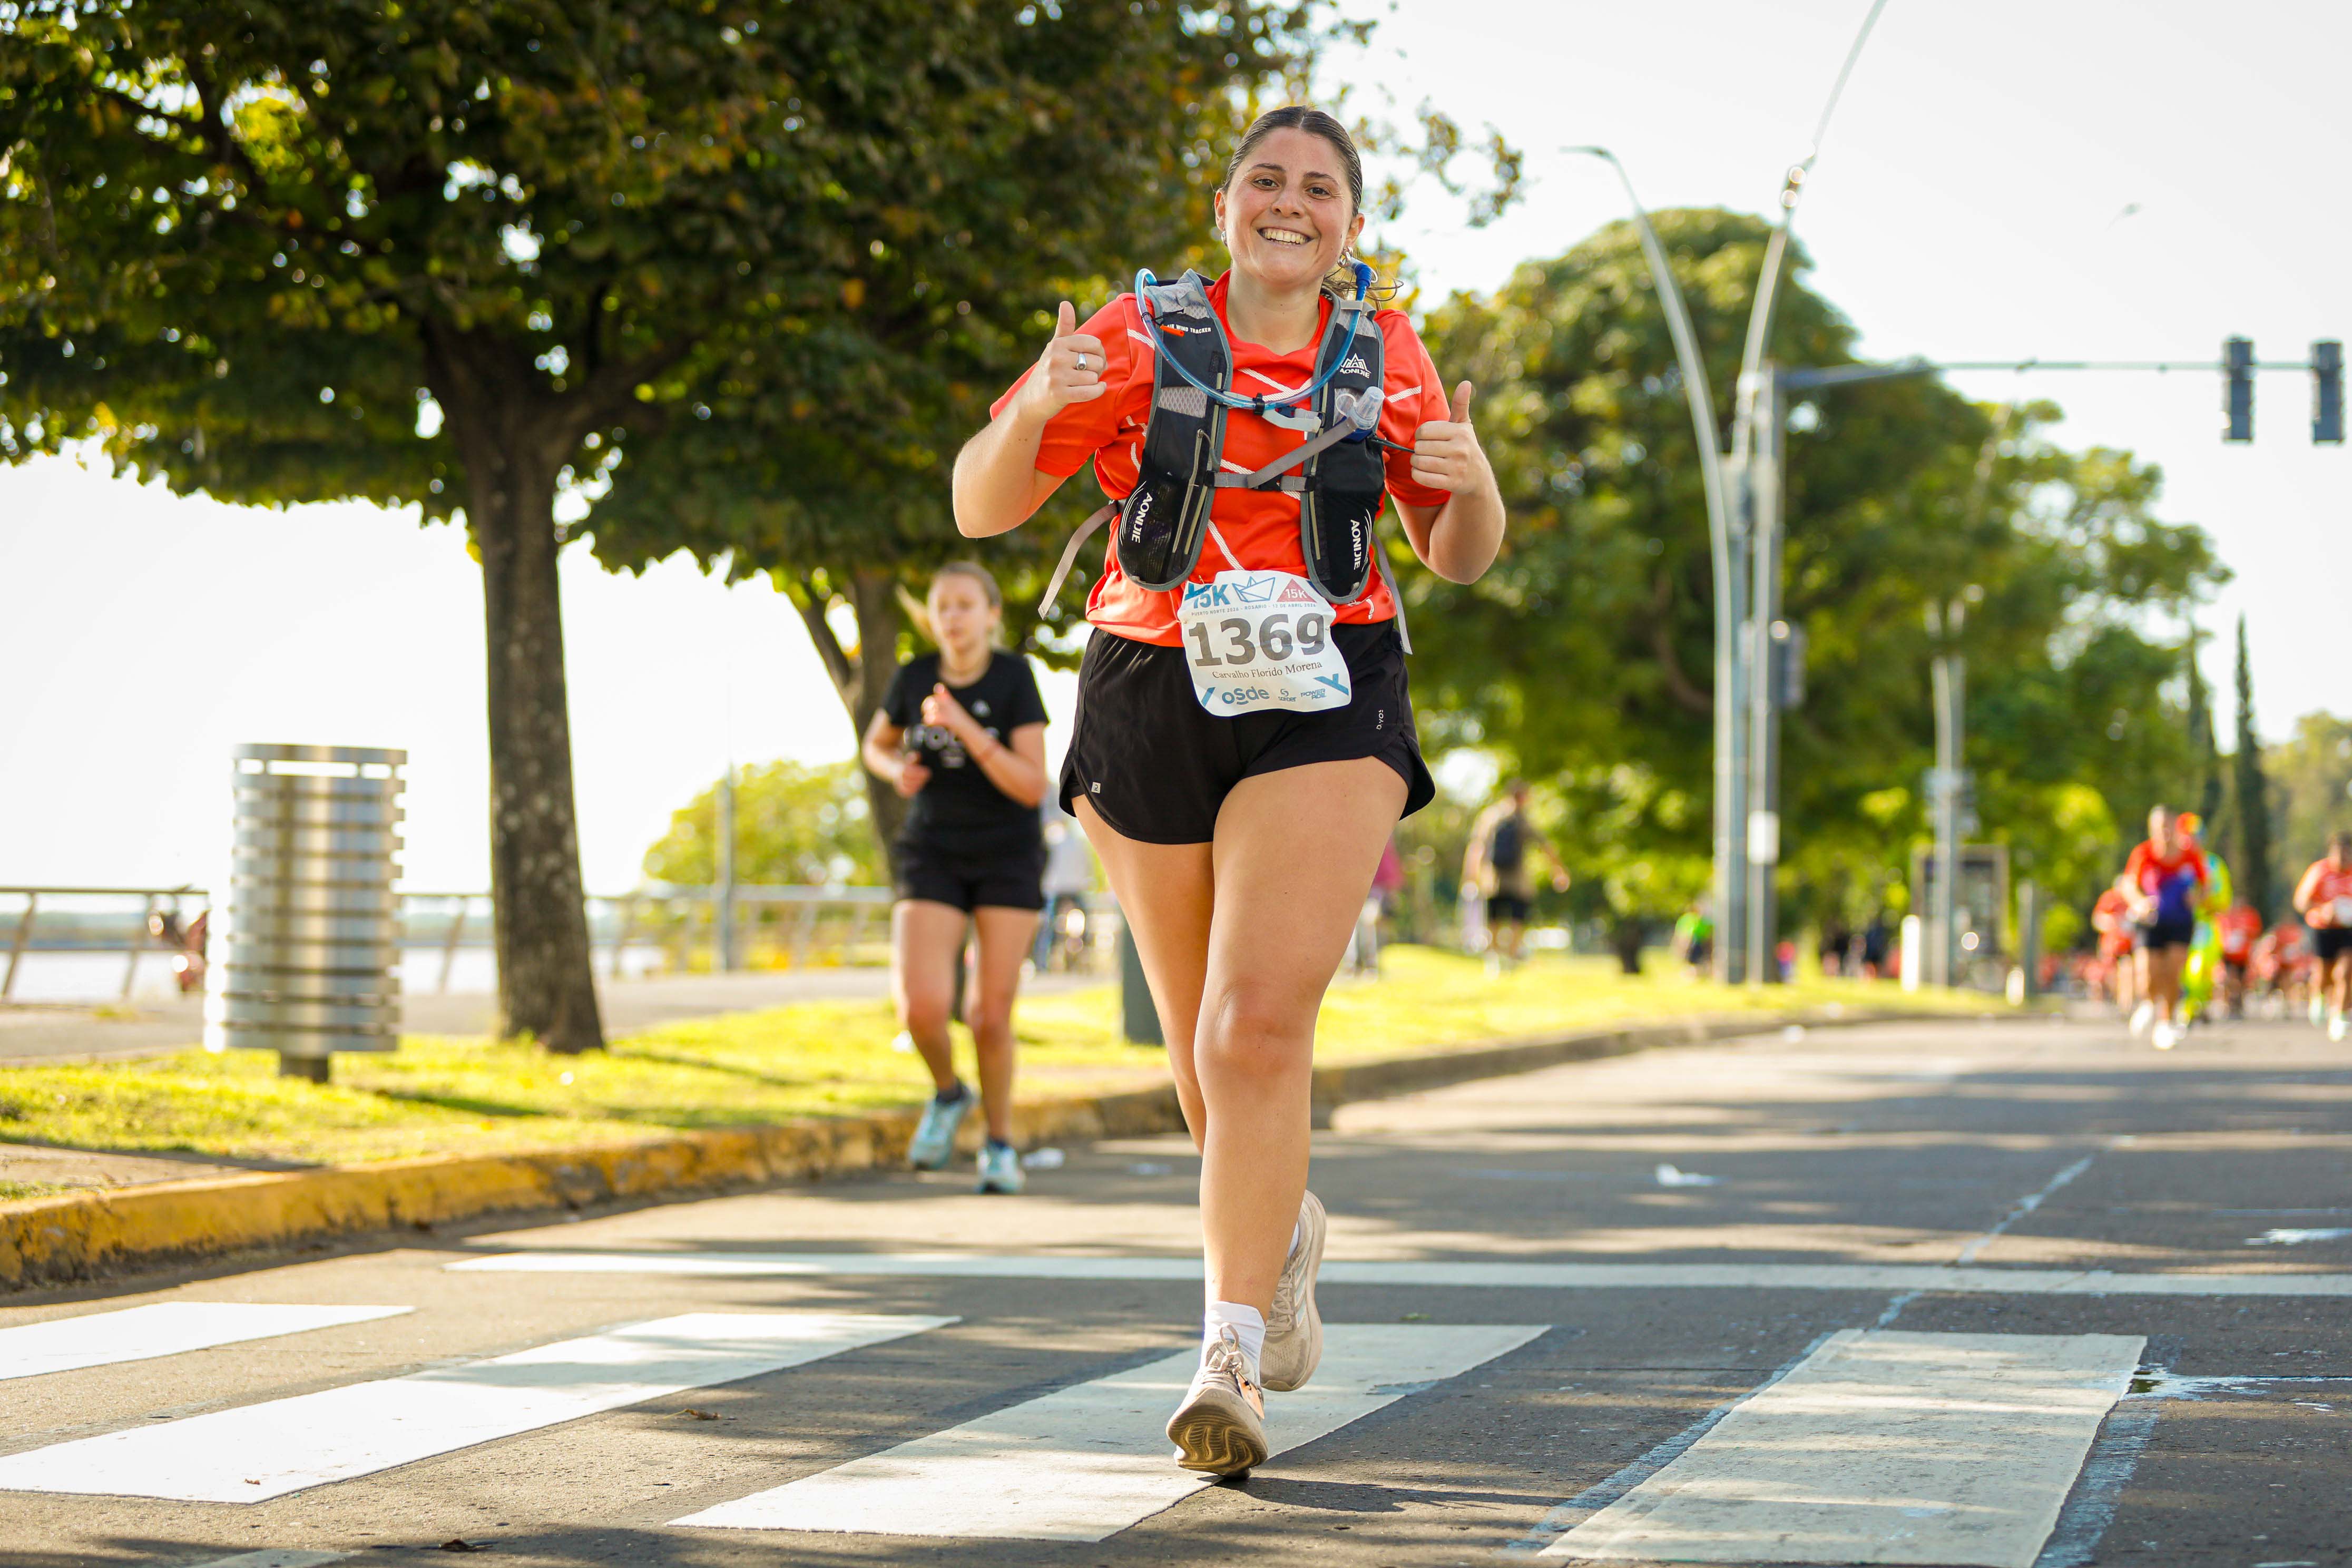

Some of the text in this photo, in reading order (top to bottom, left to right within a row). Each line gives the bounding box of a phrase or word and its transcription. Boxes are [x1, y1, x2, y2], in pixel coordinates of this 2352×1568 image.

[1340, 368, 1370, 378] AONIJIE
[1132, 492, 1153, 543] AONIJIE
[1350, 520, 1362, 570] AONIJIE
[1286, 589, 1307, 599] 15K
[1188, 613, 1325, 667] 1369
[1212, 662, 1322, 679] Carvalho Florido Morena
[1222, 686, 1270, 705] osde
[1300, 688, 1326, 697] POWER
